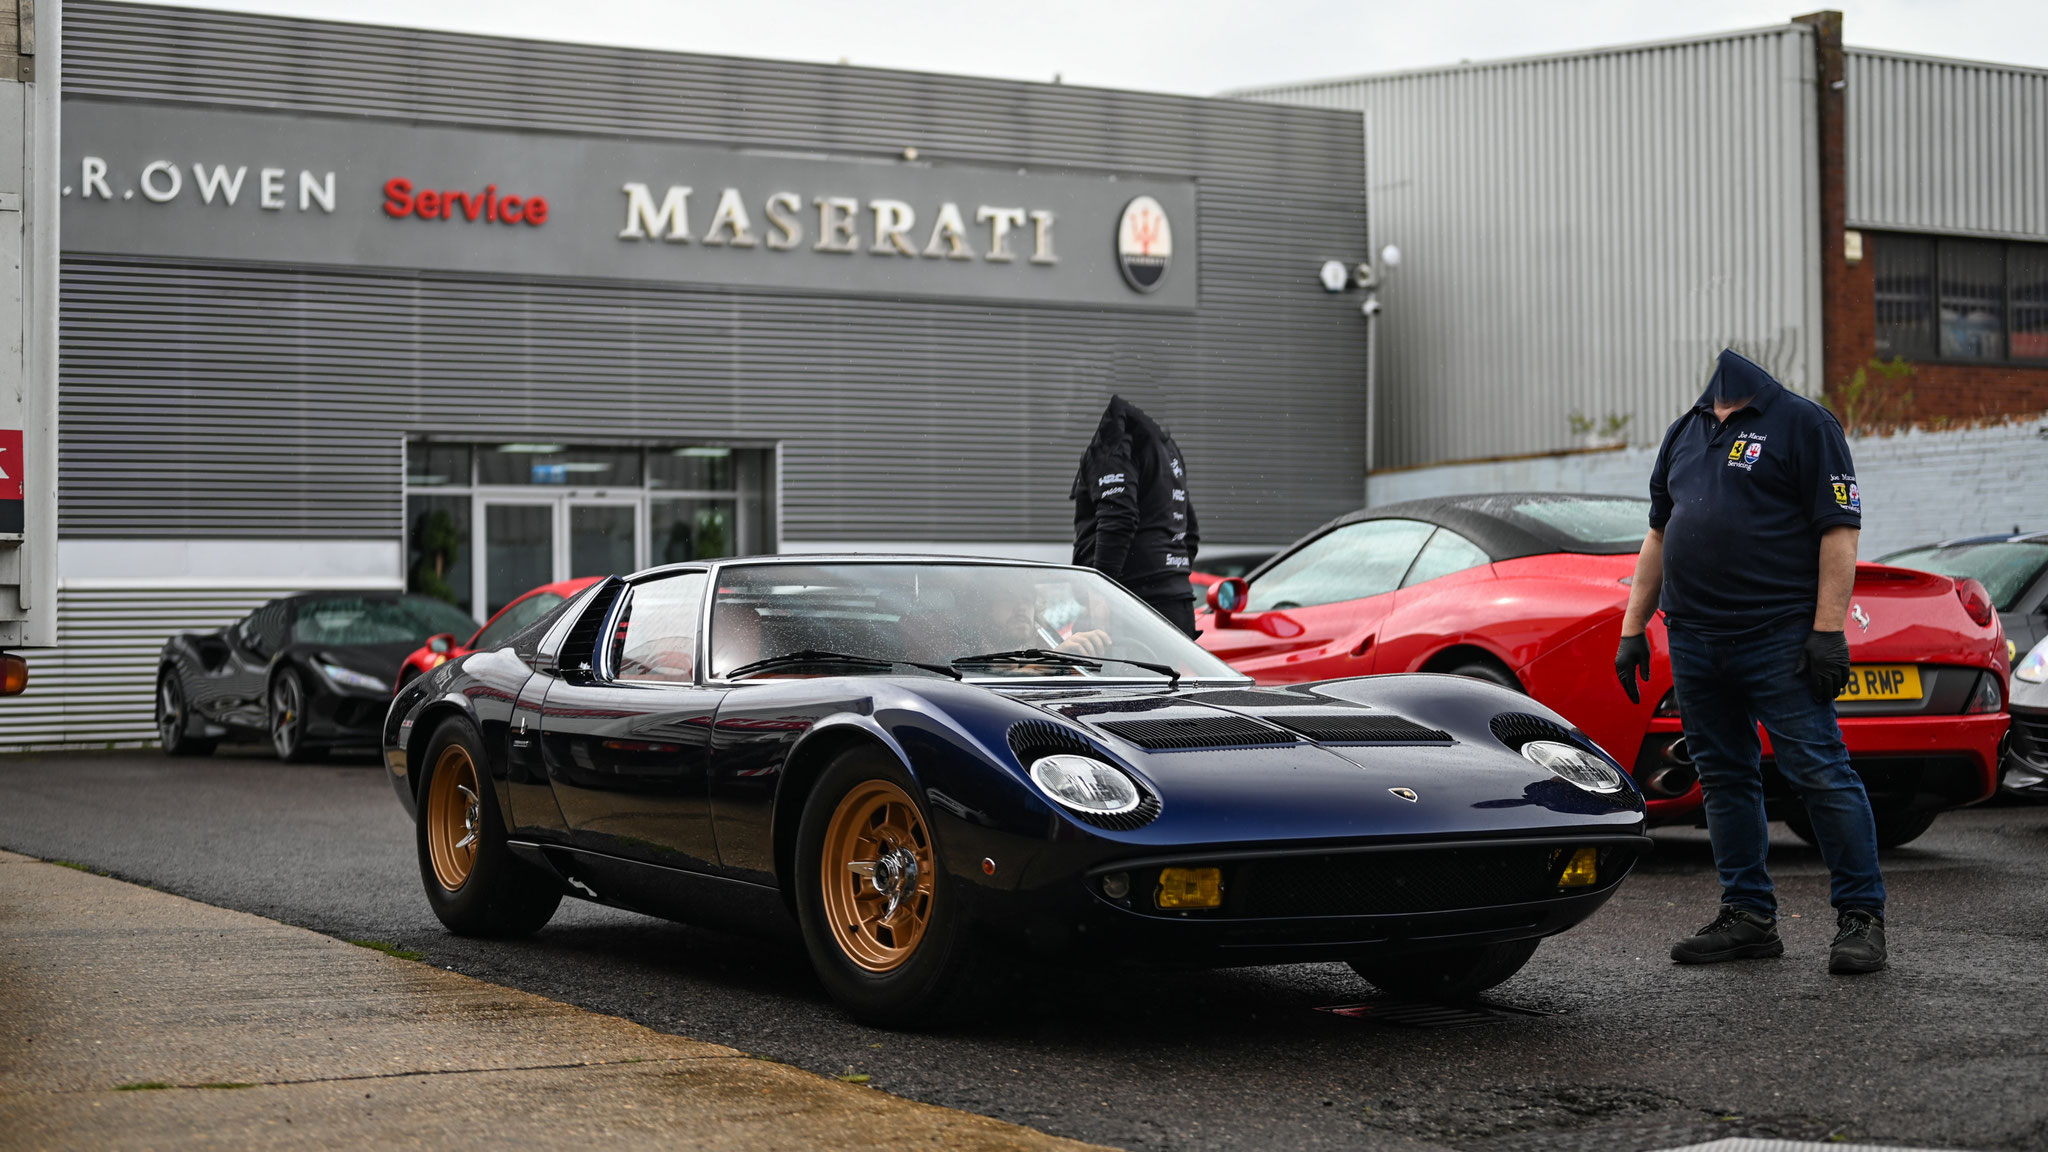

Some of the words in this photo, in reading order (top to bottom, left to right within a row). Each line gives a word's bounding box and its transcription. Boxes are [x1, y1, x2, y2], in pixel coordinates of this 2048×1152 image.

[383, 176, 549, 226] Service
[618, 181, 1060, 264] MASERATI
[1737, 431, 1748, 439] Joe
[1748, 432, 1768, 441] Macari
[1727, 460, 1752, 471] Servicing
[1864, 669, 1905, 695] RMP
